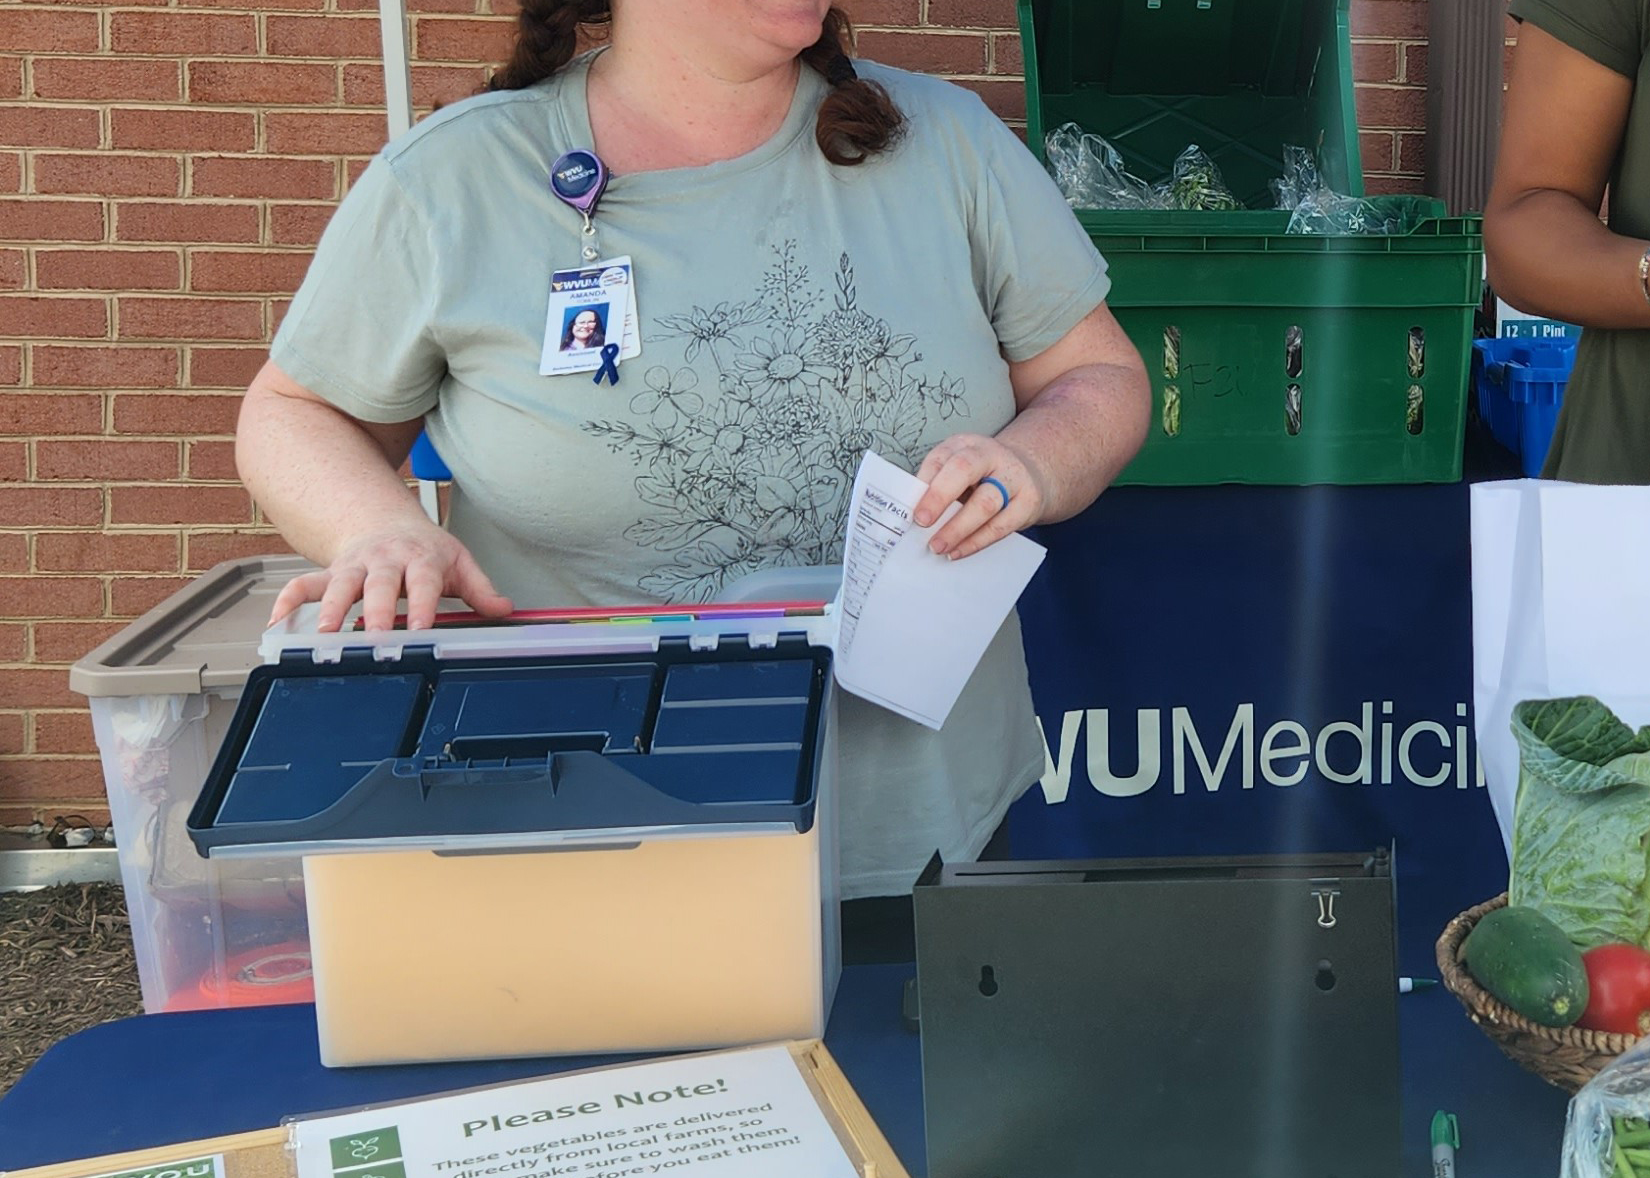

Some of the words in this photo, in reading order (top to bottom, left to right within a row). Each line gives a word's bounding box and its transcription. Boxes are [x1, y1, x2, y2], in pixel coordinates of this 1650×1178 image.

[570, 289, 607, 300] AMANDA
[1506, 324, 1518, 338] 12
[1531, 324, 1537, 338] 1
[1542, 324, 1566, 338] Pint
[462, 1101, 602, 1138] Please
[614, 1078, 728, 1109] Note!
[432, 1151, 499, 1171] These
[506, 1126, 627, 1157] vegetables
[633, 1122, 668, 1134] are
[673, 1103, 773, 1126] delivered
[453, 1158, 539, 1178] directly
[545, 1148, 601, 1163] from
[607, 1135, 658, 1152] local
[664, 1124, 734, 1142] farms,
[739, 1118, 763, 1128] so
[584, 1154, 633, 1169] sure
[639, 1149, 662, 1160] to
[667, 1137, 725, 1154] wash
[731, 1127, 788, 1142] them
[650, 1158, 690, 1173] you
[697, 1150, 732, 1162] eat
[738, 1135, 801, 1154] them!
